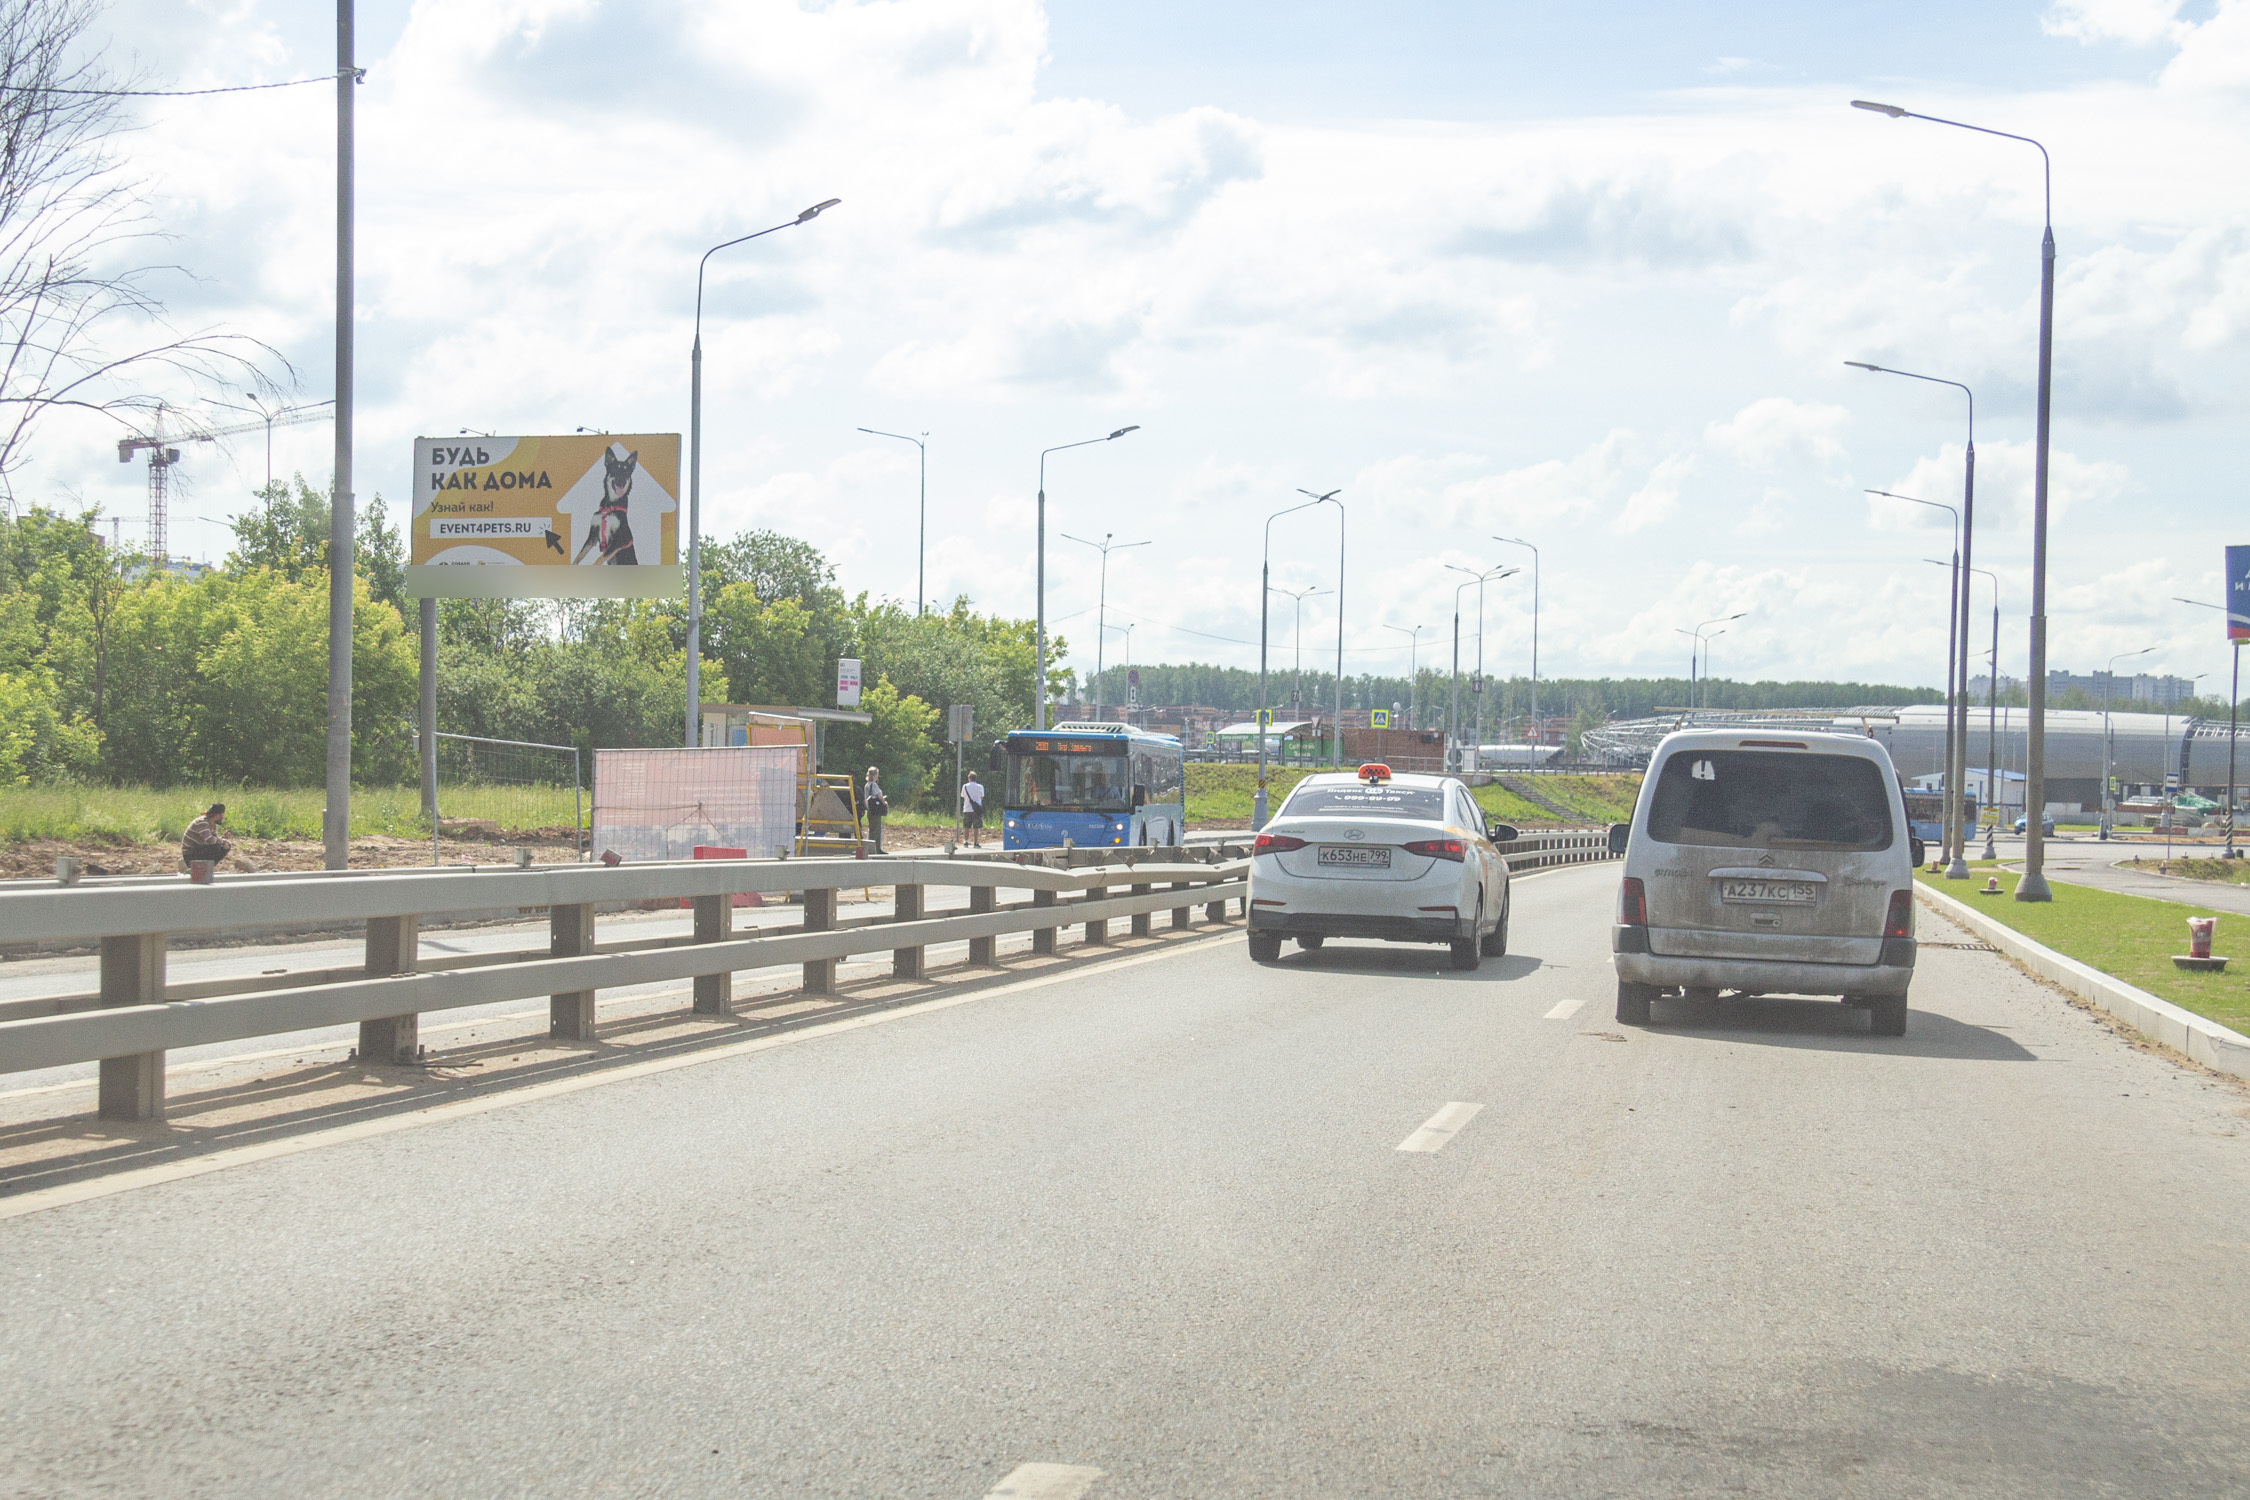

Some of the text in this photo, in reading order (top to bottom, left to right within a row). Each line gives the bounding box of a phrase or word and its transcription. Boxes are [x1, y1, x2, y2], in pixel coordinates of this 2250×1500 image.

[432, 447, 490, 467] БУДЬ
[431, 471, 552, 491] КАК ДОМА
[431, 501, 494, 513] Узнай как!
[440, 523, 531, 534] EVENT4PETS.RU
[1323, 849, 1387, 862] К653НЕ 799
[1728, 883, 1814, 898] А237КС 155
